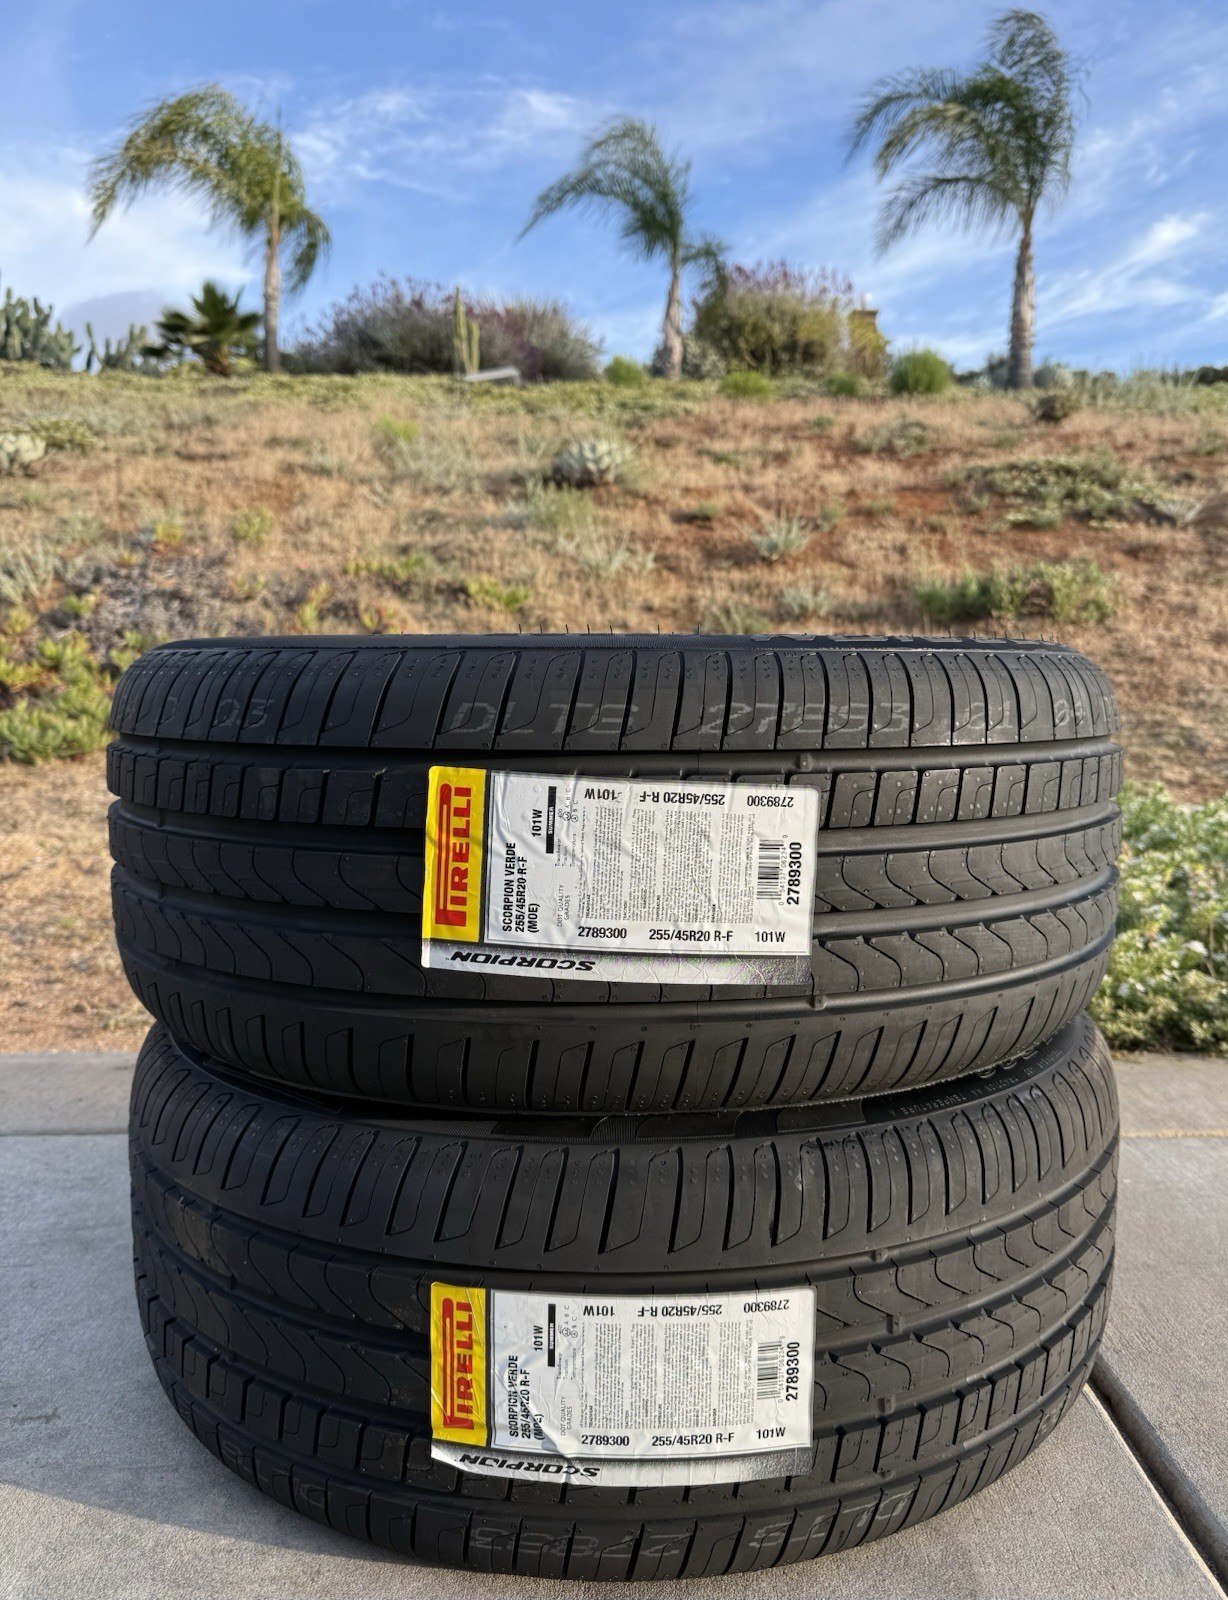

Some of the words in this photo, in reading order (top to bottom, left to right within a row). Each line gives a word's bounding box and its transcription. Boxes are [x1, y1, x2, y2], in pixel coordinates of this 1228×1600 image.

[584, 788, 616, 800] 101W
[639, 791, 659, 802] R-F
[663, 791, 725, 806] 255/45R20
[747, 795, 794, 808] 2789300
[532, 809, 543, 837] 101W
[435, 783, 471, 927] PIRELLI
[505, 842, 516, 876] VERDE
[517, 856, 528, 875] R-F
[786, 841, 802, 905] 2789300
[502, 879, 514, 932] SCORPION
[515, 877, 527, 933] 255/45R20
[528, 903, 540, 933] (MOE)
[577, 926, 627, 939] 2789300
[649, 928, 711, 942] 255/45R20
[714, 930, 733, 942] R-F
[755, 931, 786, 943] 101W
[451, 950, 596, 971] SCORPION
[583, 1305, 616, 1317] 101W
[637, 1305, 657, 1317] R-F
[661, 1304, 722, 1317] 255/45R20
[743, 1299, 789, 1313] 2789300
[533, 1325, 543, 1352] 101W
[441, 1297, 474, 1430] PIRELLI
[508, 1355, 518, 1388] VERDE
[786, 1341, 801, 1402] 2789300
[520, 1369, 530, 1387] R-F
[508, 1390, 519, 1438] SCORPION
[581, 1434, 630, 1447] 2789300
[652, 1434, 713, 1447] 255/45R20
[715, 1432, 735, 1443] R-F
[756, 1427, 786, 1440] 101W
[459, 1453, 600, 1477] SCORPION
